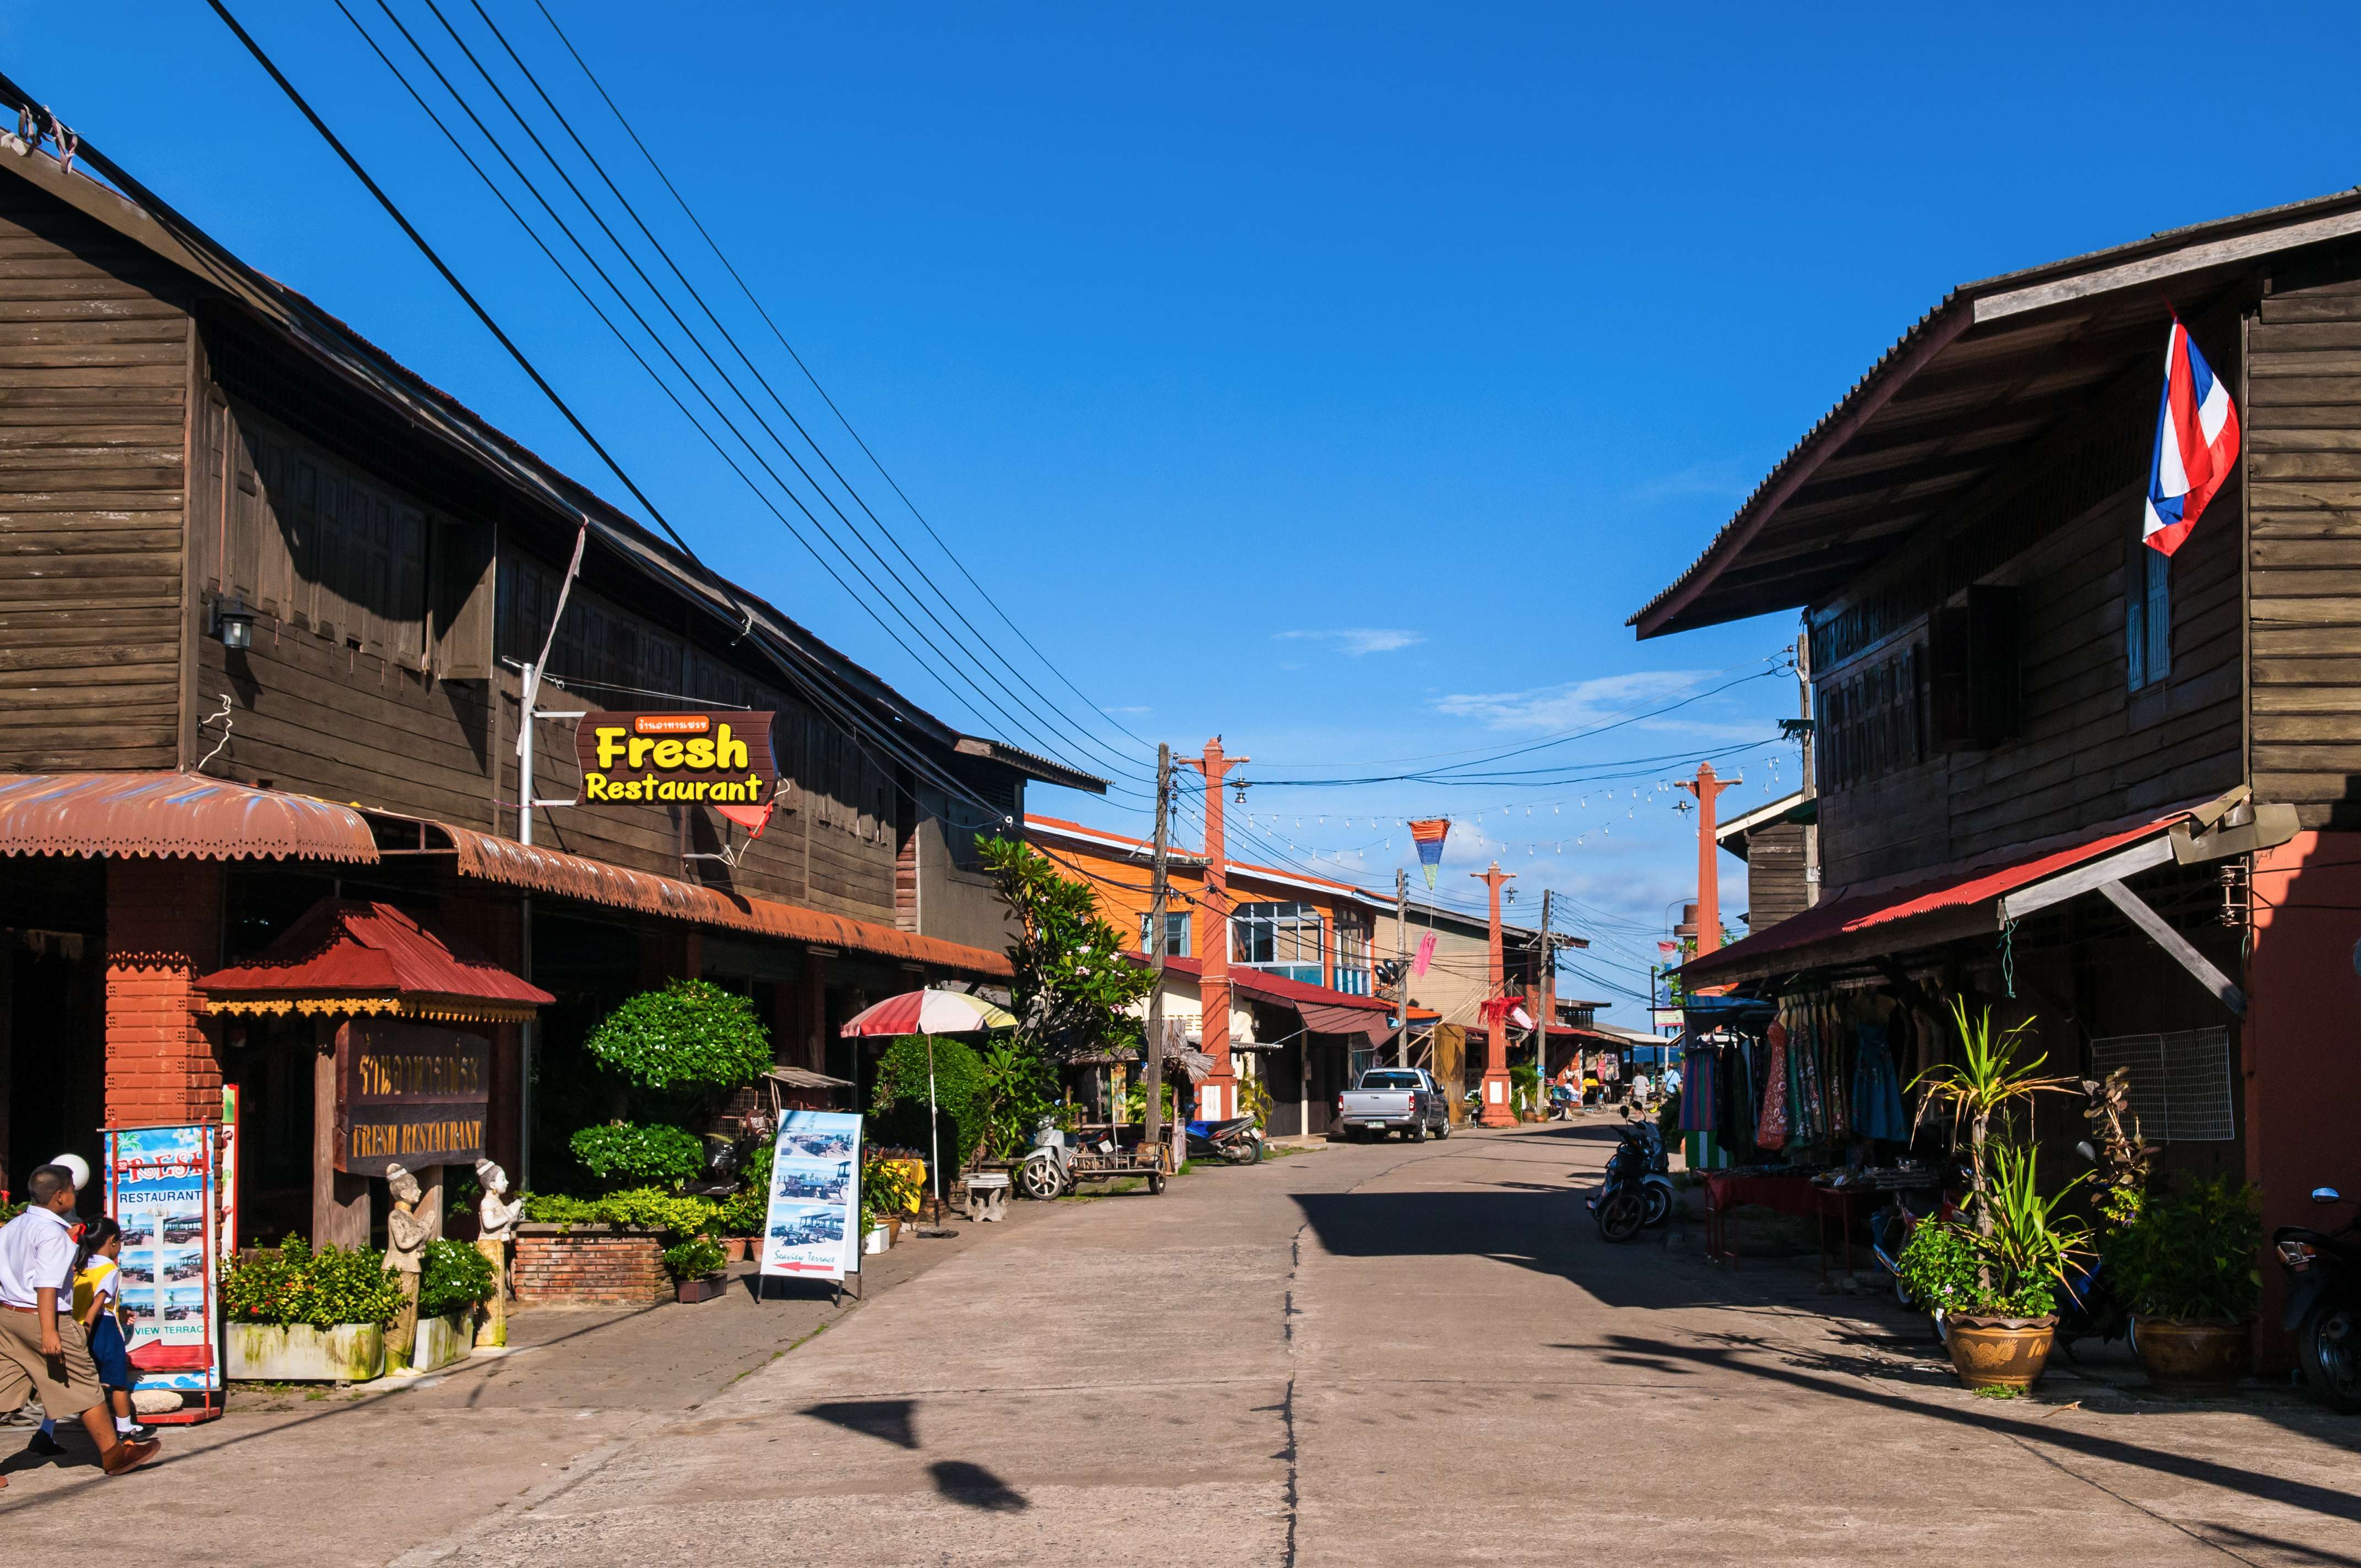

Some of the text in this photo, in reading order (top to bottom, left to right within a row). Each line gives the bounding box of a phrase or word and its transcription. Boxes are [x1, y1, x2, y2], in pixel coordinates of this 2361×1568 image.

[595, 723, 748, 769] Fresh
[585, 772, 763, 801] Restaurant
[352, 1120, 482, 1158] FRESH RESTAURANT
[120, 1190, 203, 1204] RESTAURANT
[774, 1250, 835, 1262] Seaview Terrace
[135, 1327, 160, 1336] VIEW
[164, 1325, 211, 1334] TERRAC
